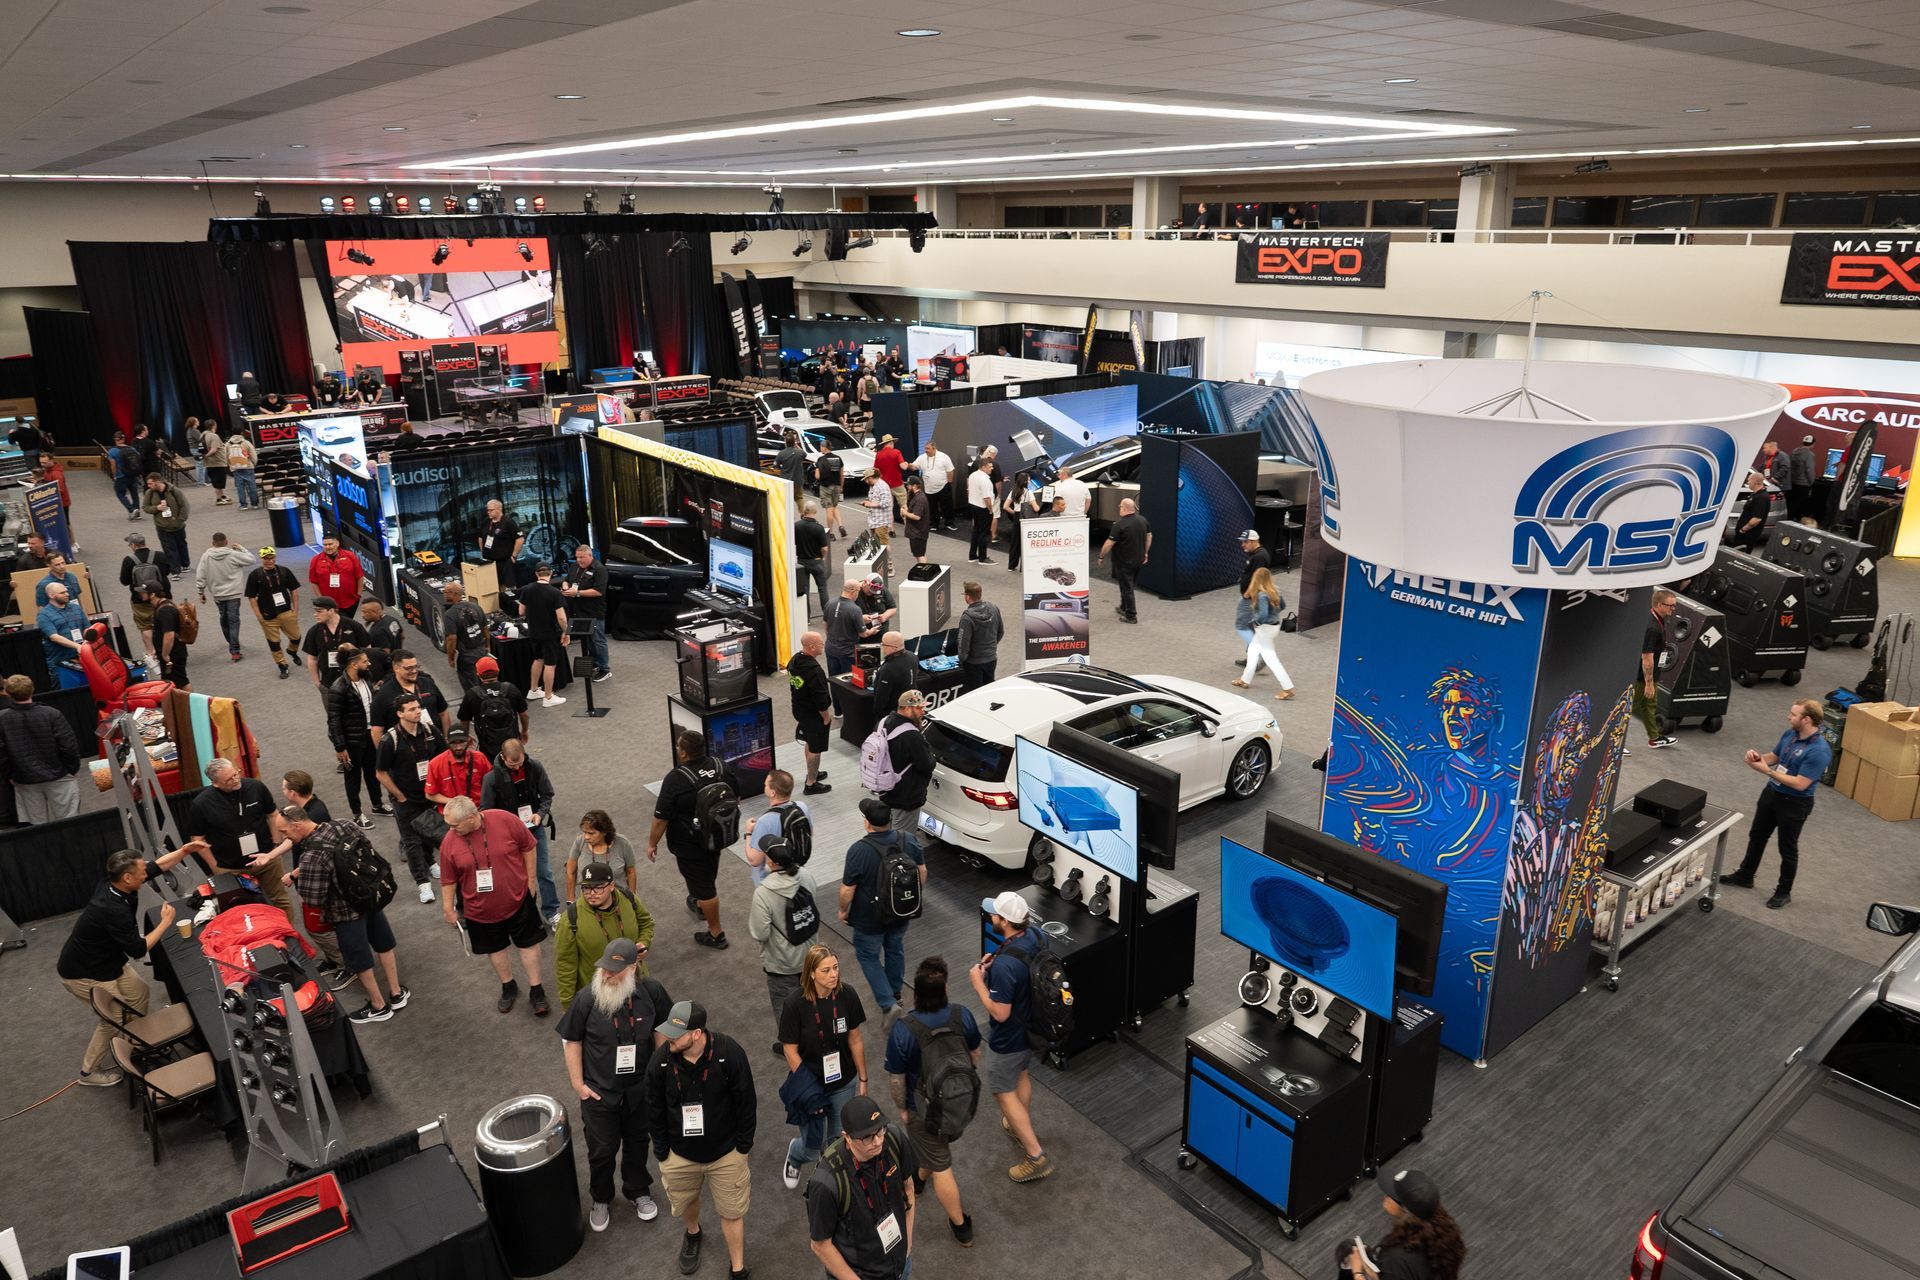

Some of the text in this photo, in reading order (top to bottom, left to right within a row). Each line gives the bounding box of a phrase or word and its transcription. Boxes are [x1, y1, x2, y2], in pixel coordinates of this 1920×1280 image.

[1257, 247, 1362, 275] EXPO
[731, 307, 750, 357] trulli
[436, 360, 477, 370] EXPO
[657, 387, 708, 400] EXPO
[1813, 406, 1867, 424] ARC
[1855, 437, 1873, 474] AUDIO
[336, 474, 369, 510] audison
[1027, 530, 1060, 539] ESCORT
[1030, 538, 1062, 547] REDLINE
[1511, 508, 1720, 573] MSC
[1390, 589, 1508, 626] GERMAN CAR HIFI
[1042, 640, 1087, 651] AWAKENED
